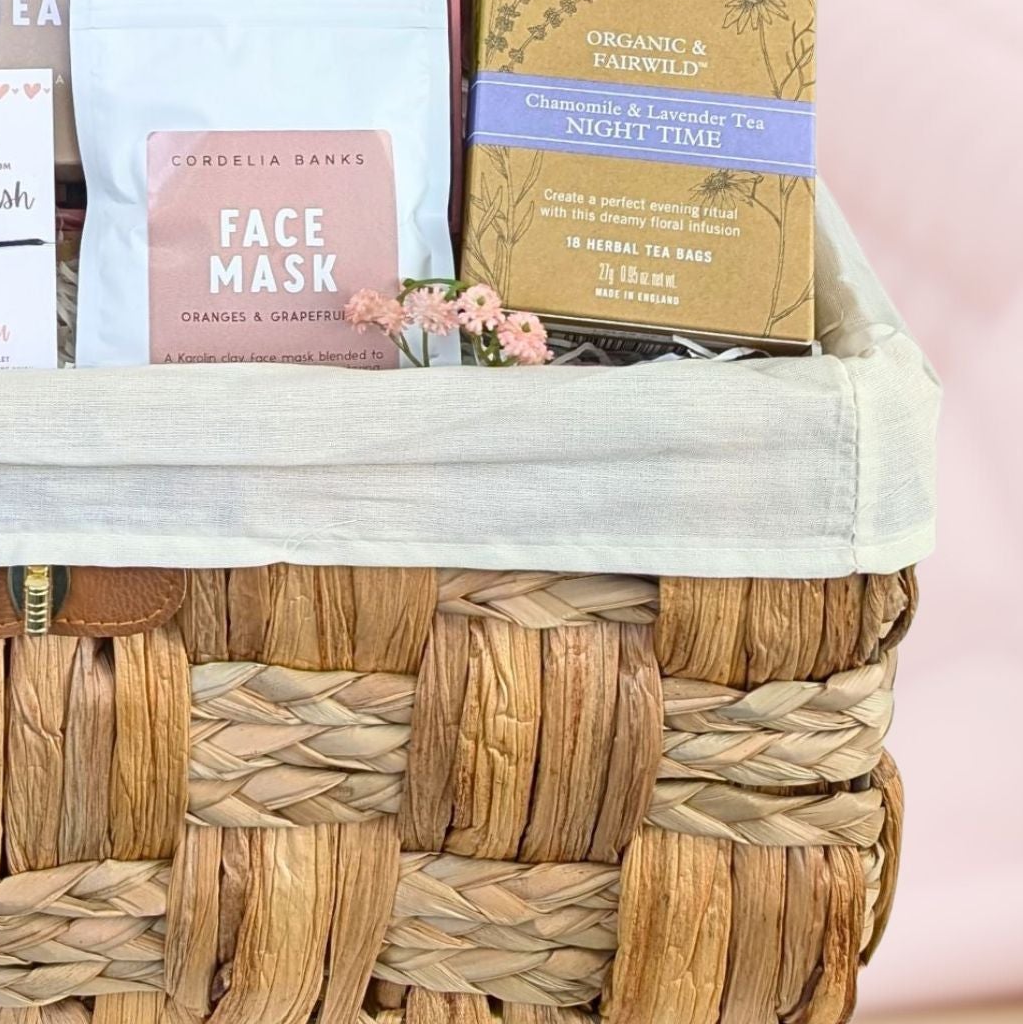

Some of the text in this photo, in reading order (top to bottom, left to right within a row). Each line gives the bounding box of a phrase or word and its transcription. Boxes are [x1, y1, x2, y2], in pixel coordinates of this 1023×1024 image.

[586, 30, 708, 56] ORGANIC &
[525, 93, 765, 130] Chamomile & Lavender Tea
[566, 117, 722, 149] NIGHT TIME
[171, 153, 366, 167] CORDELIA BANKS
[544, 188, 738, 220] Create a perfect evening ritual
[220, 207, 325, 247] FACE
[540, 205, 741, 237] with this dreamy floral infusion
[566, 236, 713, 263] 18 HERBAL TEA BAGS
[209, 254, 338, 294] MASK
[599, 262, 614, 285] 27g
[595, 288, 680, 305] MADE IN ENGLAND
[181, 310, 347, 322] ORANGES & GRAPEFRUI
[164, 353, 172, 363] A
[221, 352, 245, 363] clay
[250, 353, 277, 363] face
[281, 351, 315, 363] mask
[319, 349, 367, 362] blended
[372, 349, 385, 360] to
